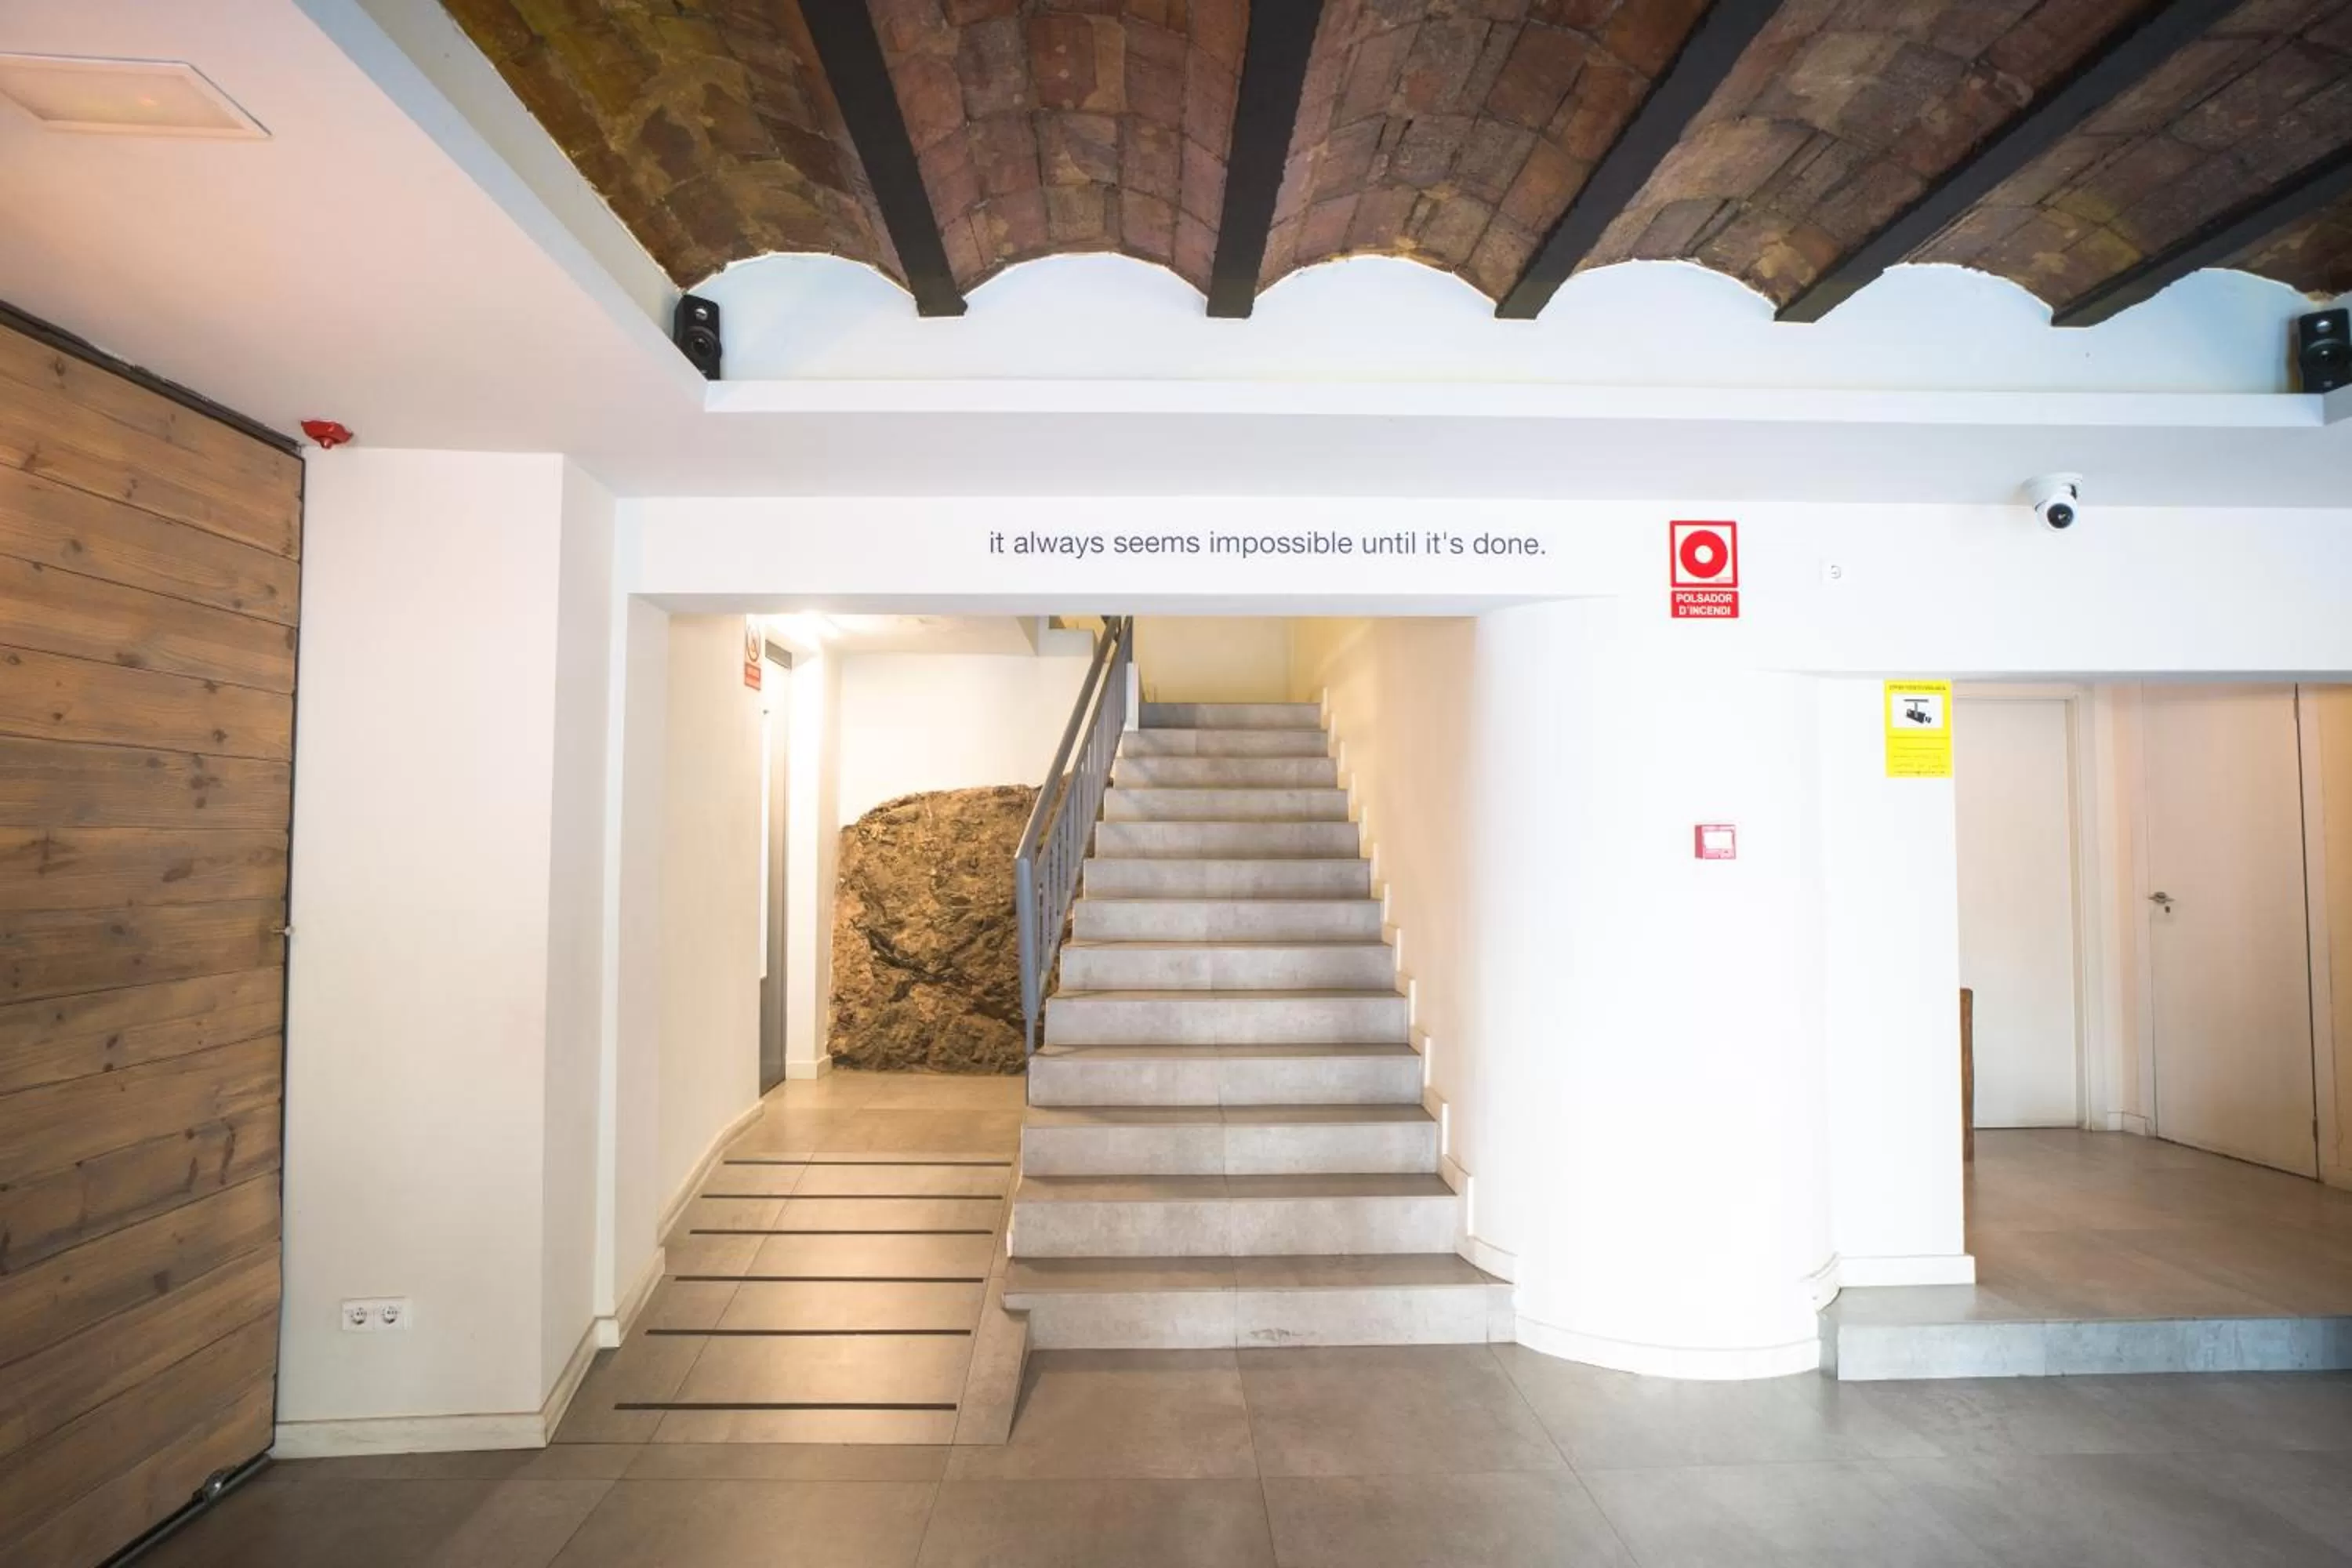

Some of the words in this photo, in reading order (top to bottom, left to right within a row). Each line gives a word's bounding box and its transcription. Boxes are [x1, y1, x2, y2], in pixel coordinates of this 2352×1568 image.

[990, 530, 1004, 554] it
[1013, 530, 1105, 560] always
[1113, 535, 1201, 554] seems
[1210, 530, 1353, 559] impossible
[1362, 531, 1416, 555] until
[1426, 531, 1465, 555] it's
[1472, 532, 1546, 556] done.
[1675, 593, 1733, 603] POLSADOR
[1679, 605, 1731, 615] D'INCENDI
